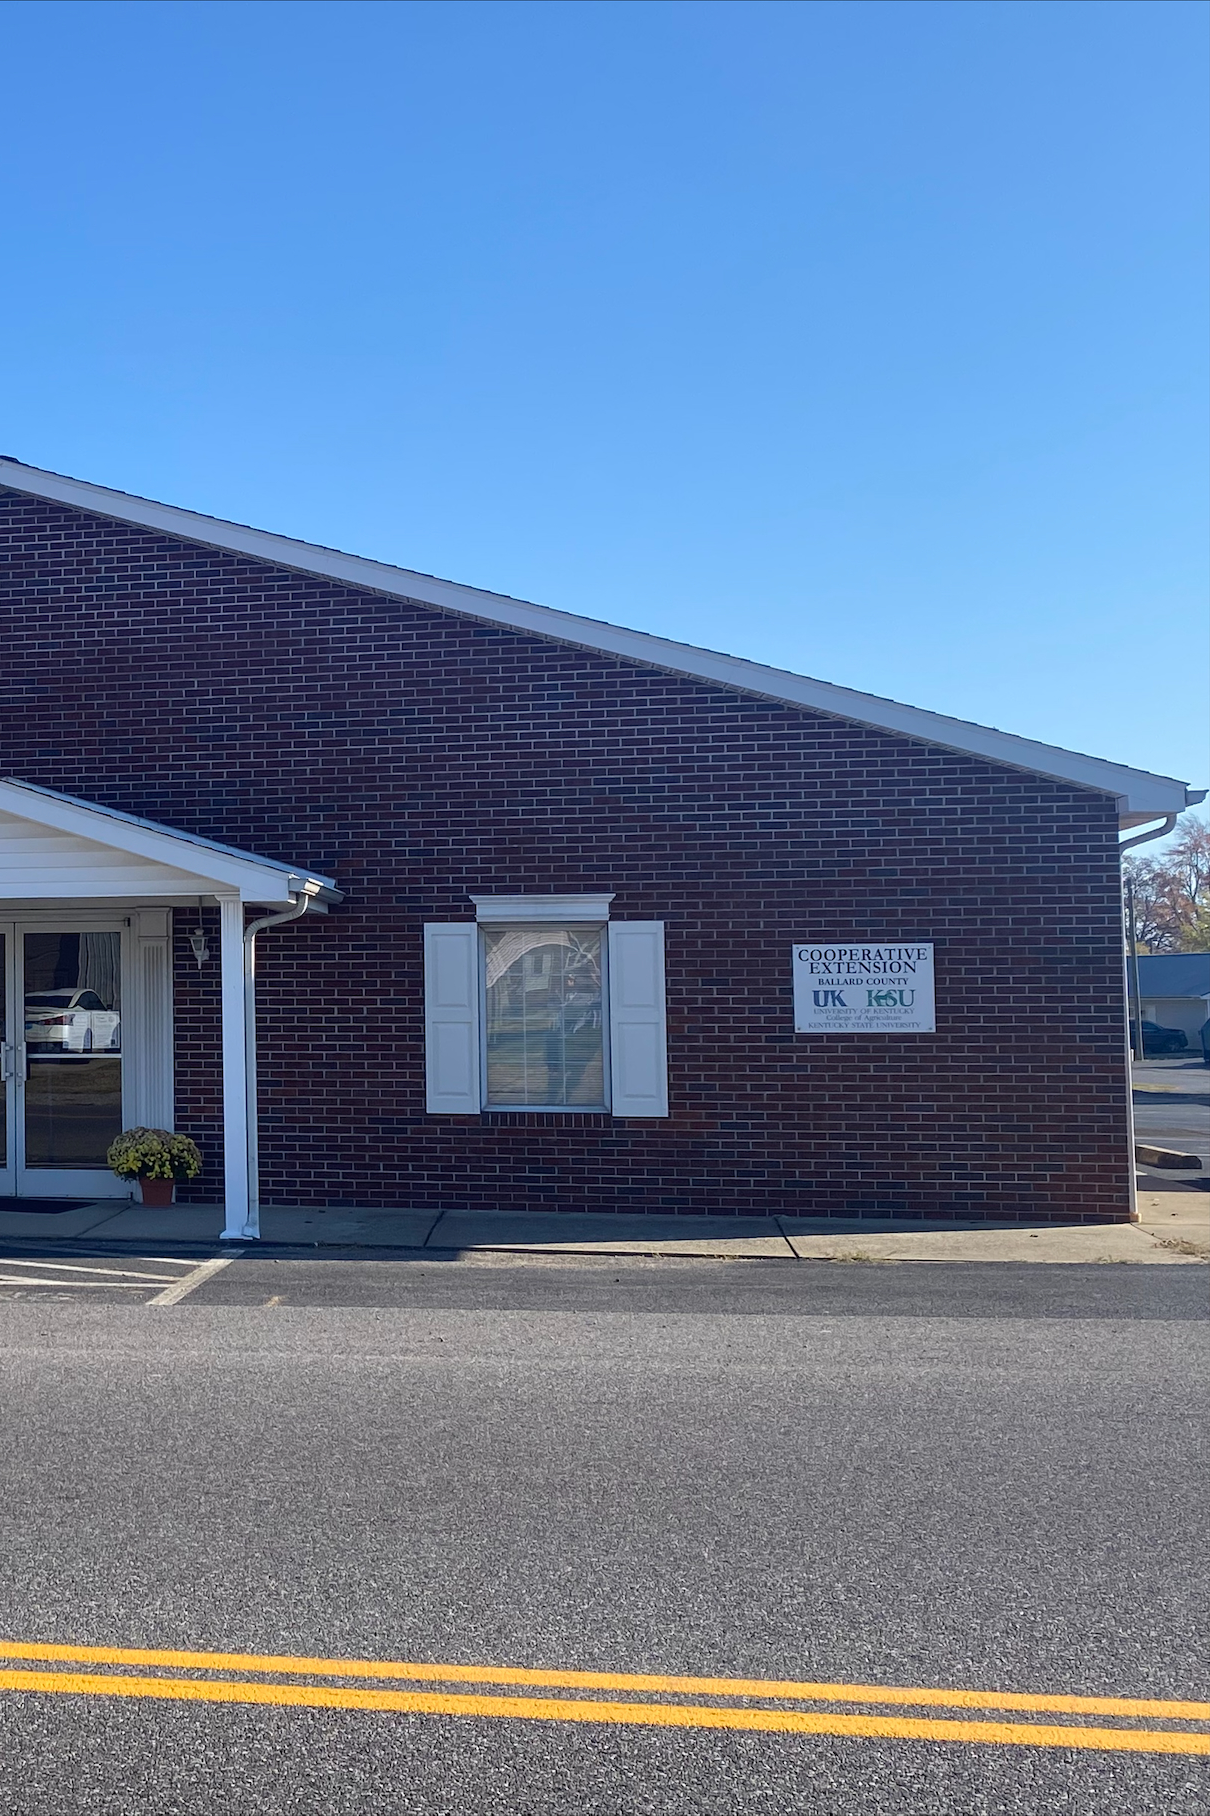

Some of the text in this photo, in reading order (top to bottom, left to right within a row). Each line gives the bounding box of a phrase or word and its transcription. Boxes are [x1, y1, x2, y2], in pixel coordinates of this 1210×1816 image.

[798, 948, 928, 962] COOPERATIVE
[808, 961, 917, 975] EXTENSION
[818, 978, 863, 986] BALLARD
[812, 990, 848, 1007] UK
